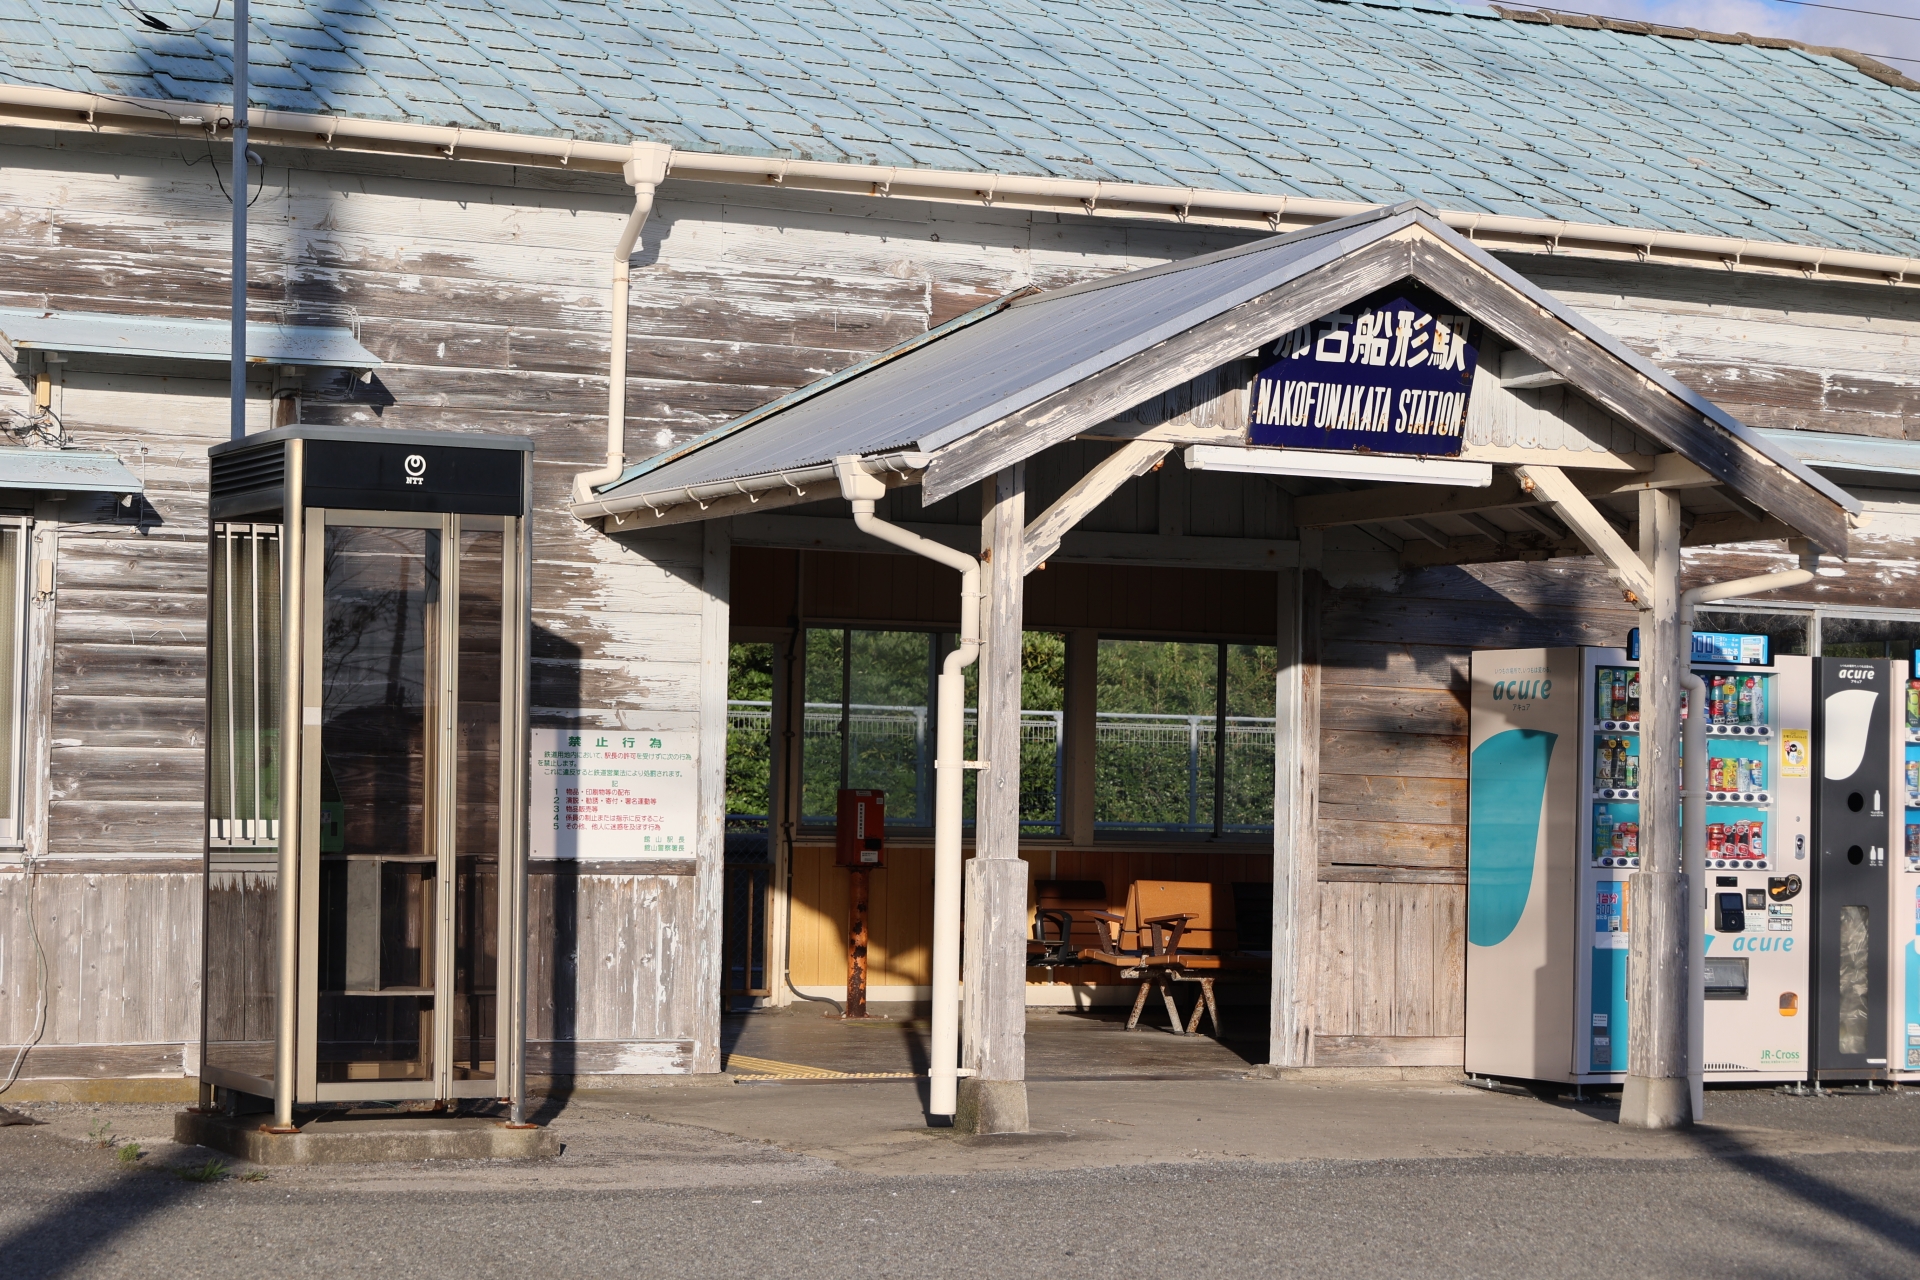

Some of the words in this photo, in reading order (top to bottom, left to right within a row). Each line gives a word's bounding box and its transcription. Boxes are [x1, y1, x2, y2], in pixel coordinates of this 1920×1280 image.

[1256, 378, 1392, 433] NAKOFUNAKATA
[1395, 388, 1466, 437] STATION
[405, 476, 424, 485] NTT
[1838, 669, 1875, 679] acure
[1493, 679, 1552, 700] acure
[1512, 703, 1531, 711] アキュア
[568, 736, 662, 748] 禁止行為
[544, 768, 683, 777] これに違反すると鉄道営業法により処罰されます。
[565, 814, 665, 823] 係員の制止または指示に反すること
[1732, 936, 1794, 952] acure
